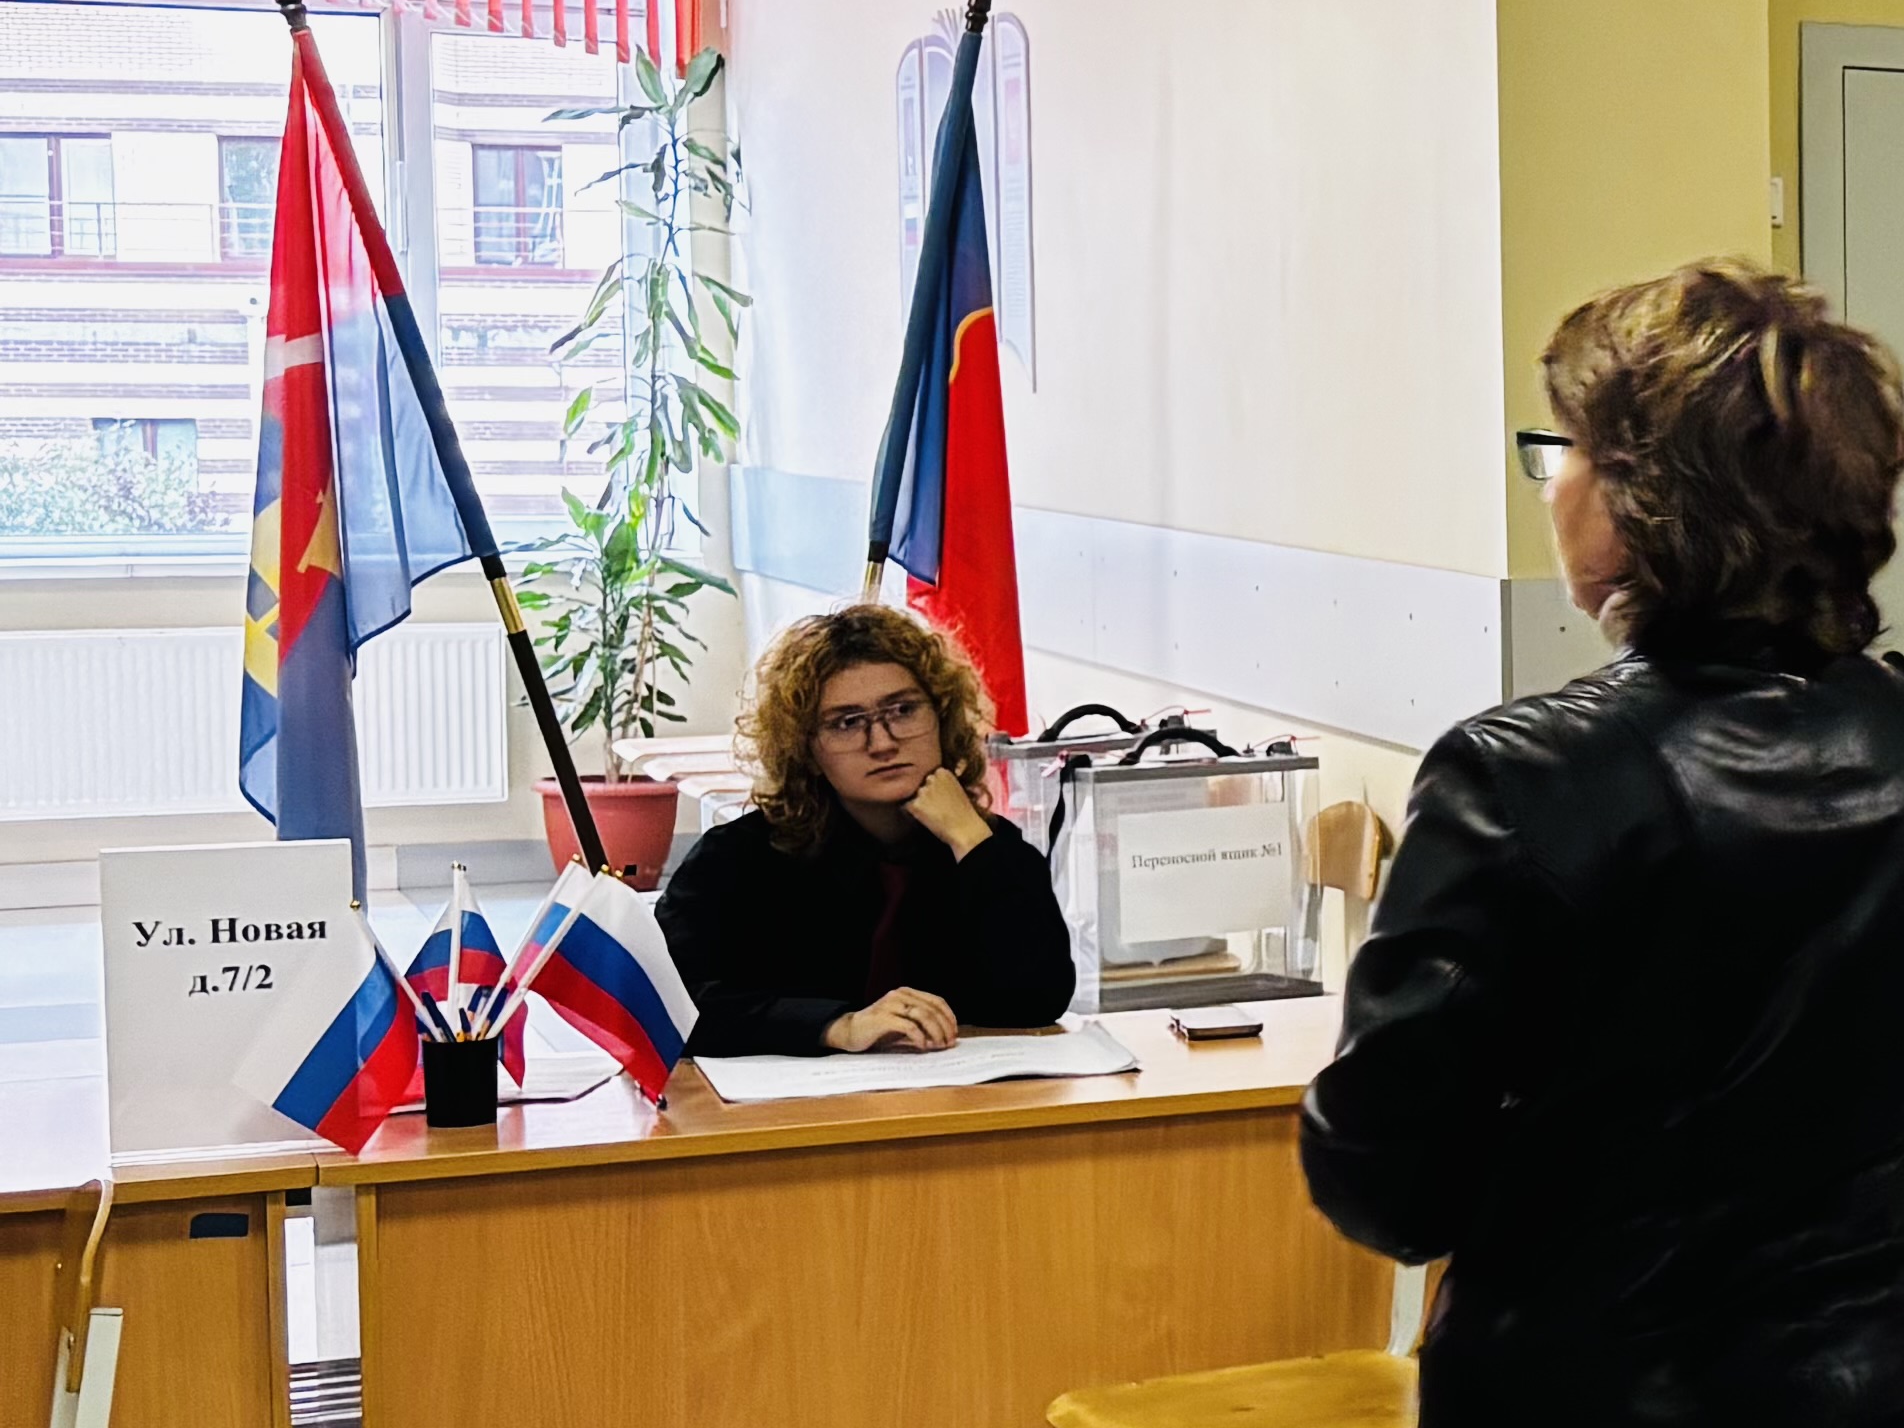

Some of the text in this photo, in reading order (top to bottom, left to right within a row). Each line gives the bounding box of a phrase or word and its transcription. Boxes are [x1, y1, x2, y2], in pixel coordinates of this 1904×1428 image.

[1131, 842, 1282, 870] Переносной ящик №1
[132, 917, 327, 947] Ул. Новая
[188, 964, 273, 997] д.7/2
